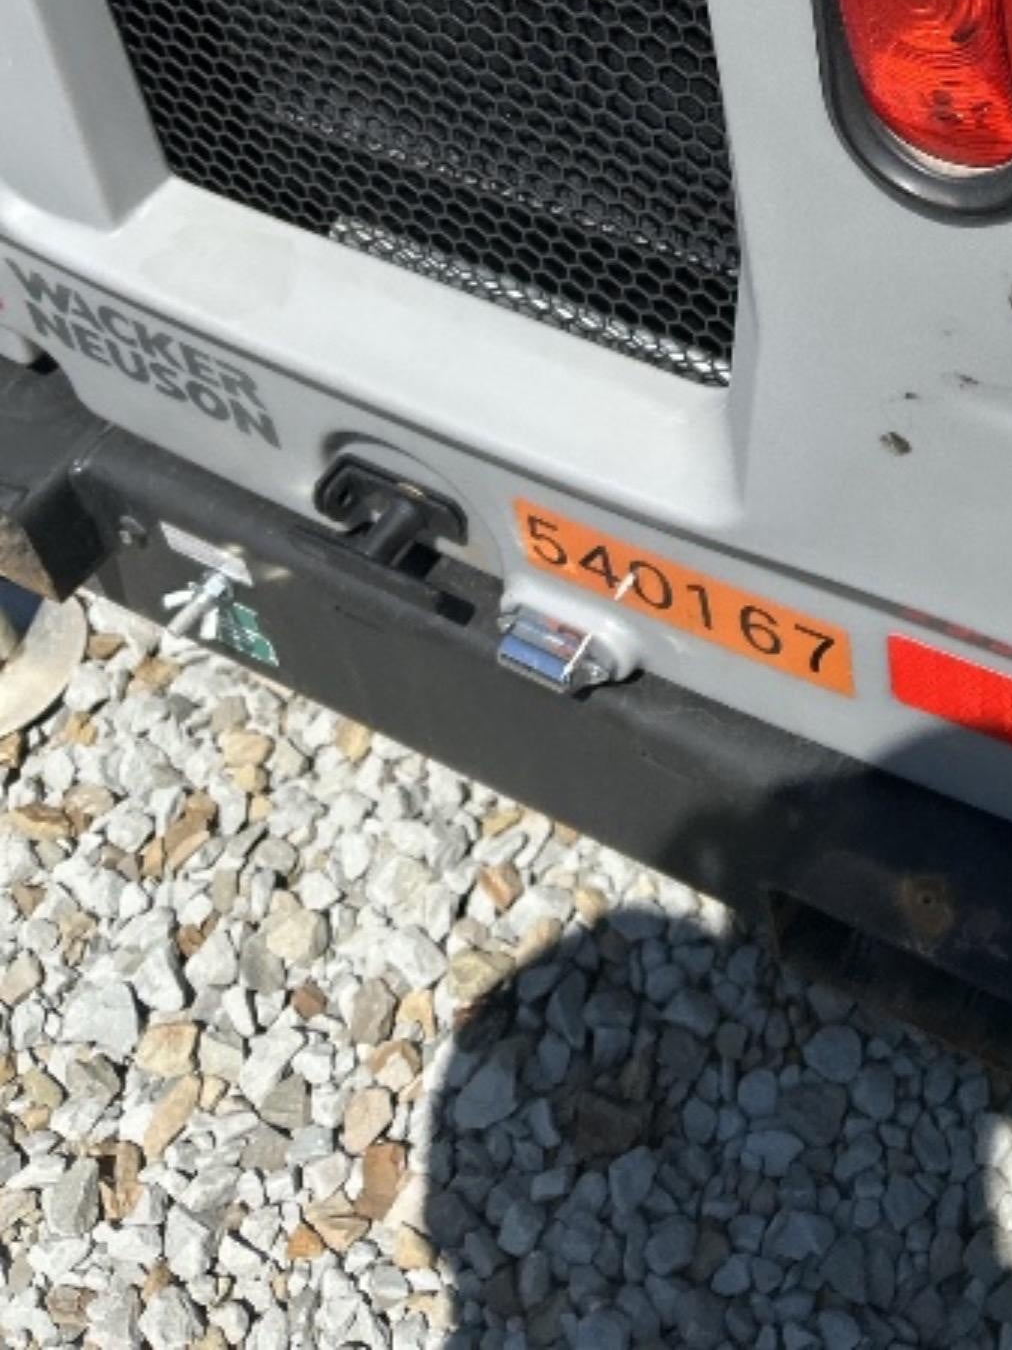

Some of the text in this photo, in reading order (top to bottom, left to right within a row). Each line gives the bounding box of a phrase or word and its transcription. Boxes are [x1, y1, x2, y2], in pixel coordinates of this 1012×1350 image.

[5, 257, 268, 412] WACKER
[24, 299, 283, 450] NEUSON
[526, 514, 836, 674] 540167
